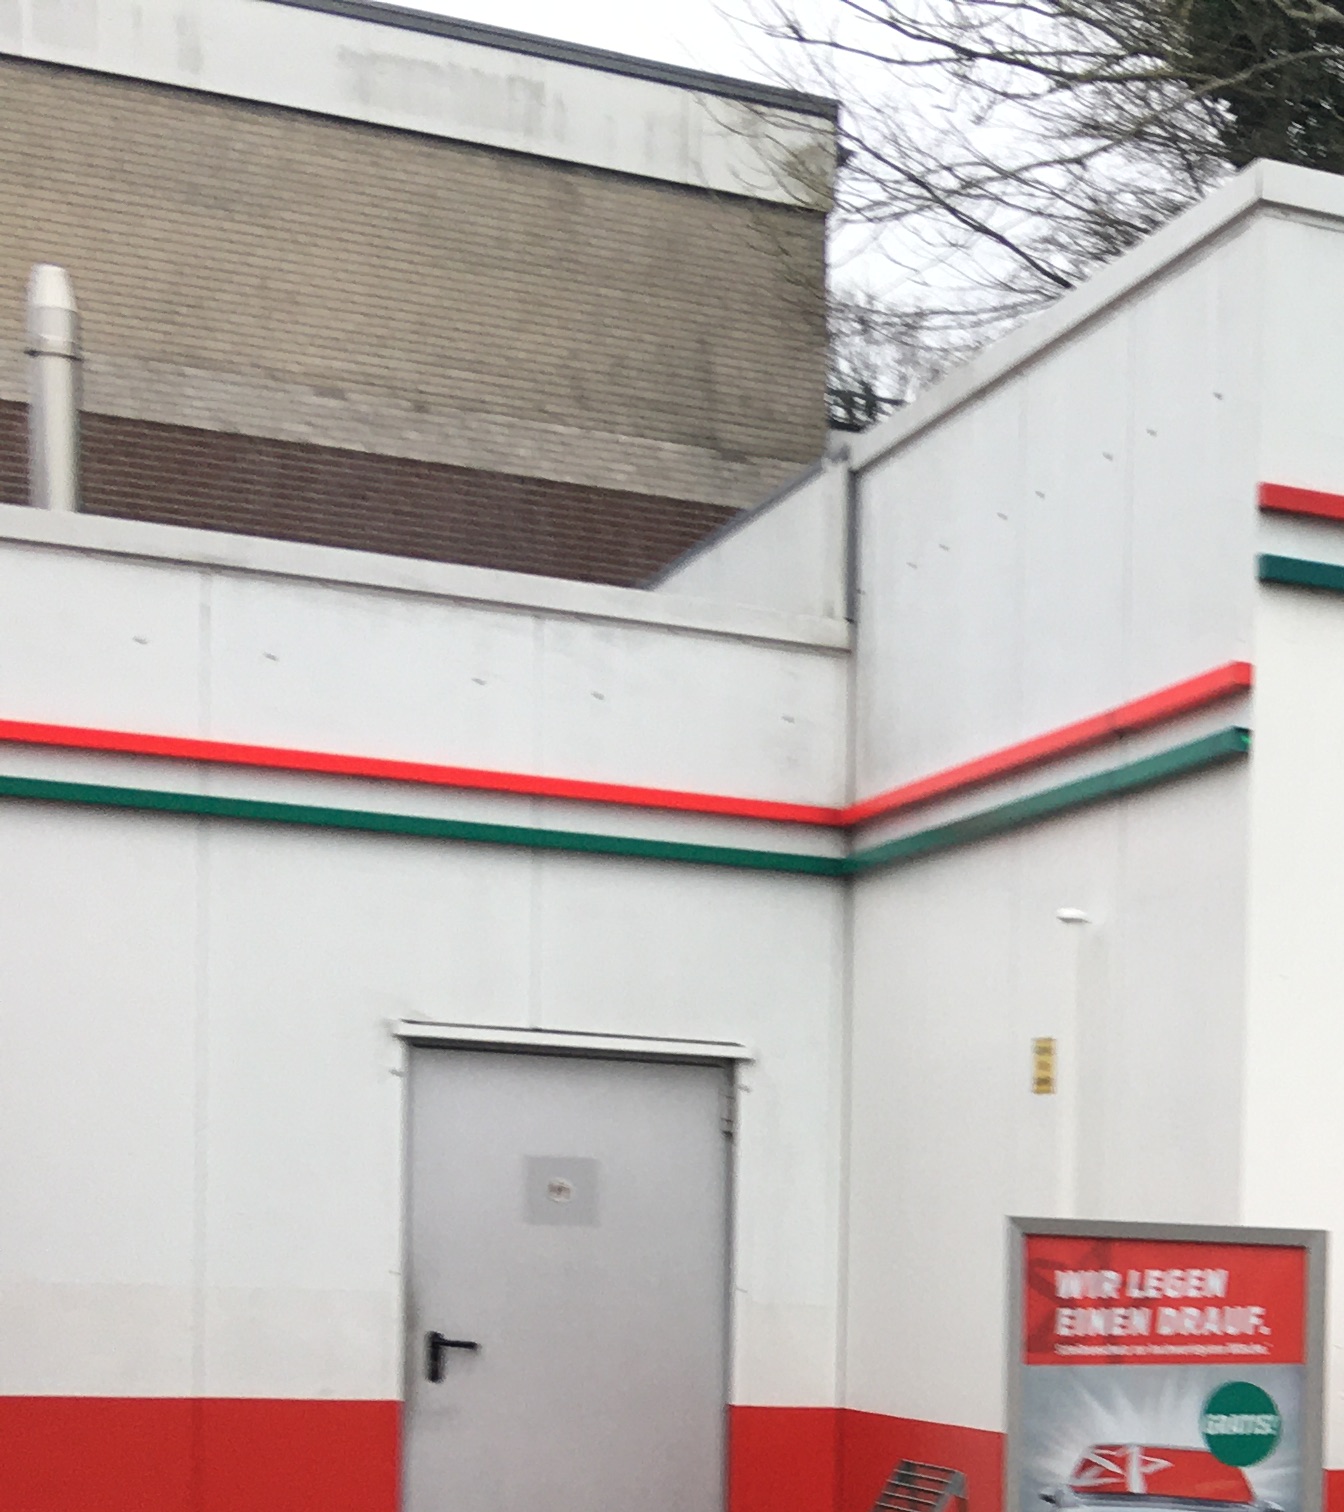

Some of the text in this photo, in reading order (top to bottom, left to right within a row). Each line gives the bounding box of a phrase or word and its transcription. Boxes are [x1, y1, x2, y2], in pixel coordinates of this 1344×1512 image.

[1055, 1269, 1229, 1299] WIR LEGEN
[1055, 1306, 1152, 1336] EINEN
